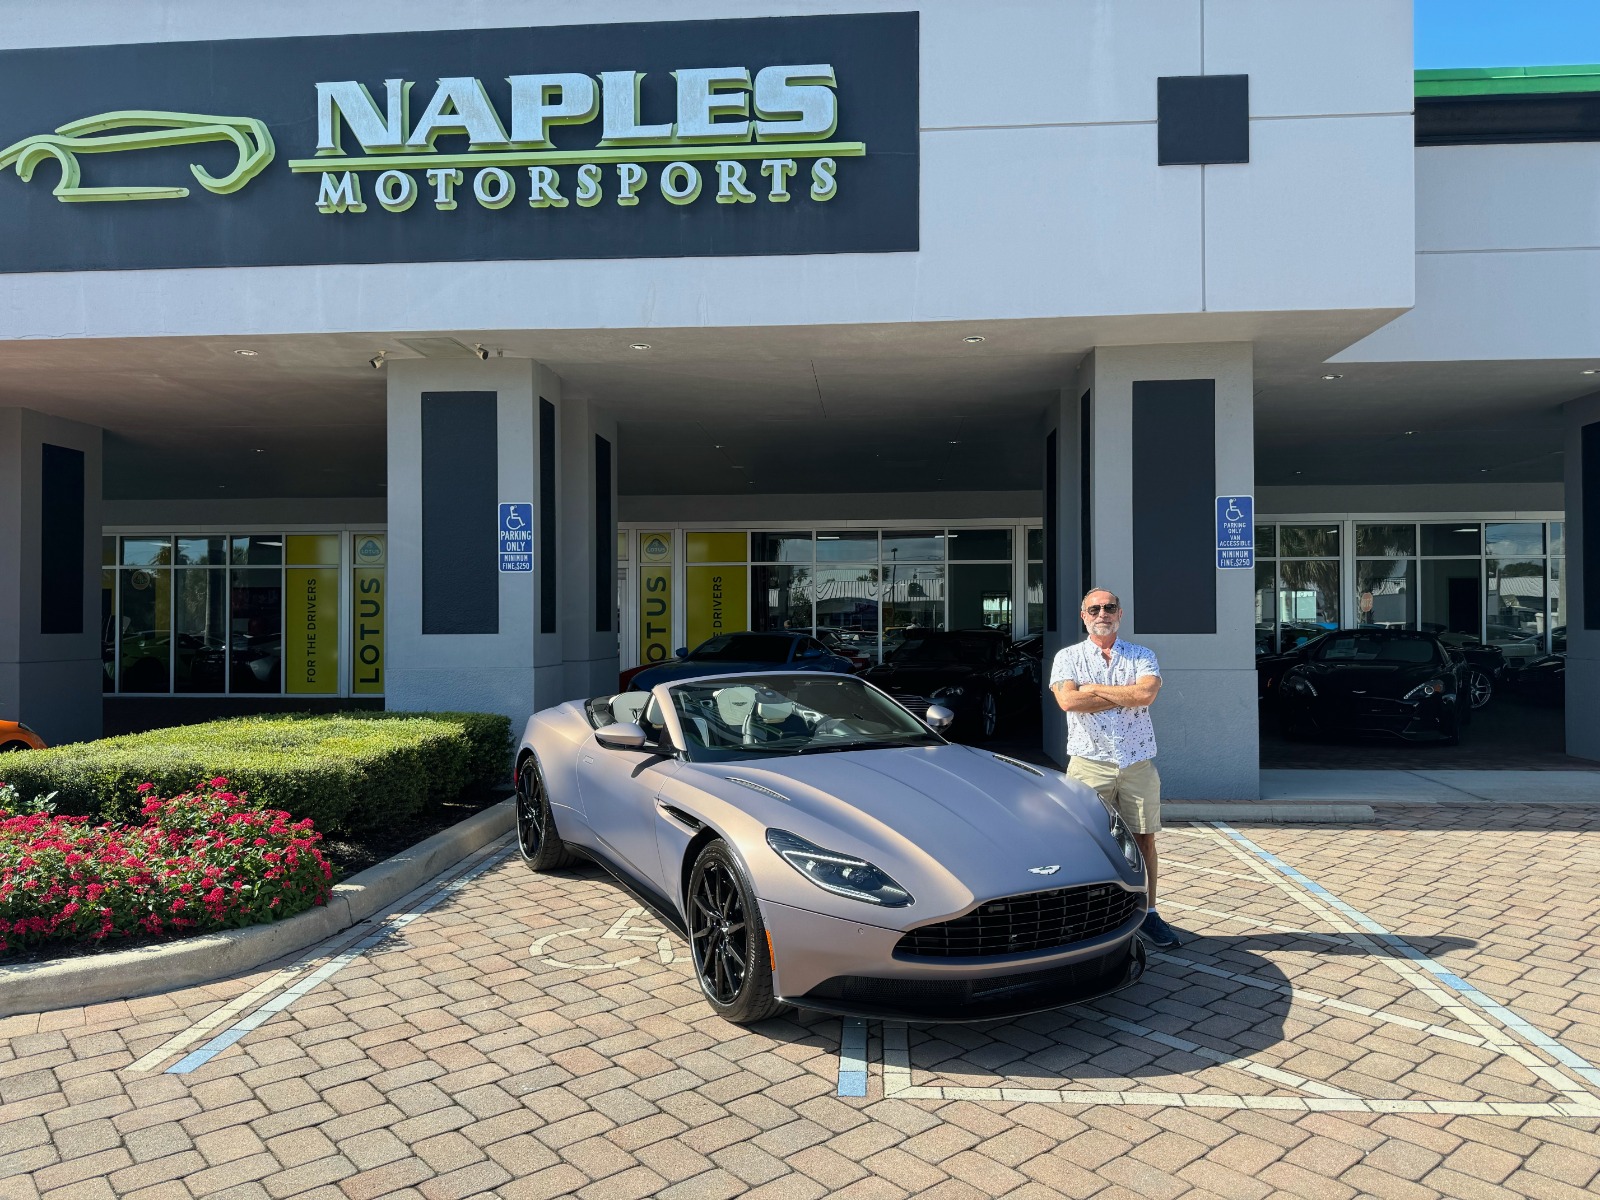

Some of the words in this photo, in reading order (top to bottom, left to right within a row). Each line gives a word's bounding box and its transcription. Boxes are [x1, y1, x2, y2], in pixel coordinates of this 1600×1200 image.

[315, 64, 837, 155] NAPLES
[316, 158, 837, 213] MOTORSPORTS
[500, 530, 532, 540] PARKING
[506, 541, 526, 551] ONLY
[504, 554, 529, 562] MINIMUM
[1220, 559, 1234, 567] FINE
[1235, 558, 1251, 567] $250
[1222, 550, 1249, 558] MINIMUM
[502, 562, 515, 570] FINE
[516, 562, 530, 570] $250
[307, 578, 317, 630] DRIVERS
[712, 576, 722, 629] DRIVERS
[359, 577, 381, 684] LOTUS
[646, 576, 667, 663] OTUS
[306, 633, 316, 656] THE
[306, 659, 316, 683] FOR
